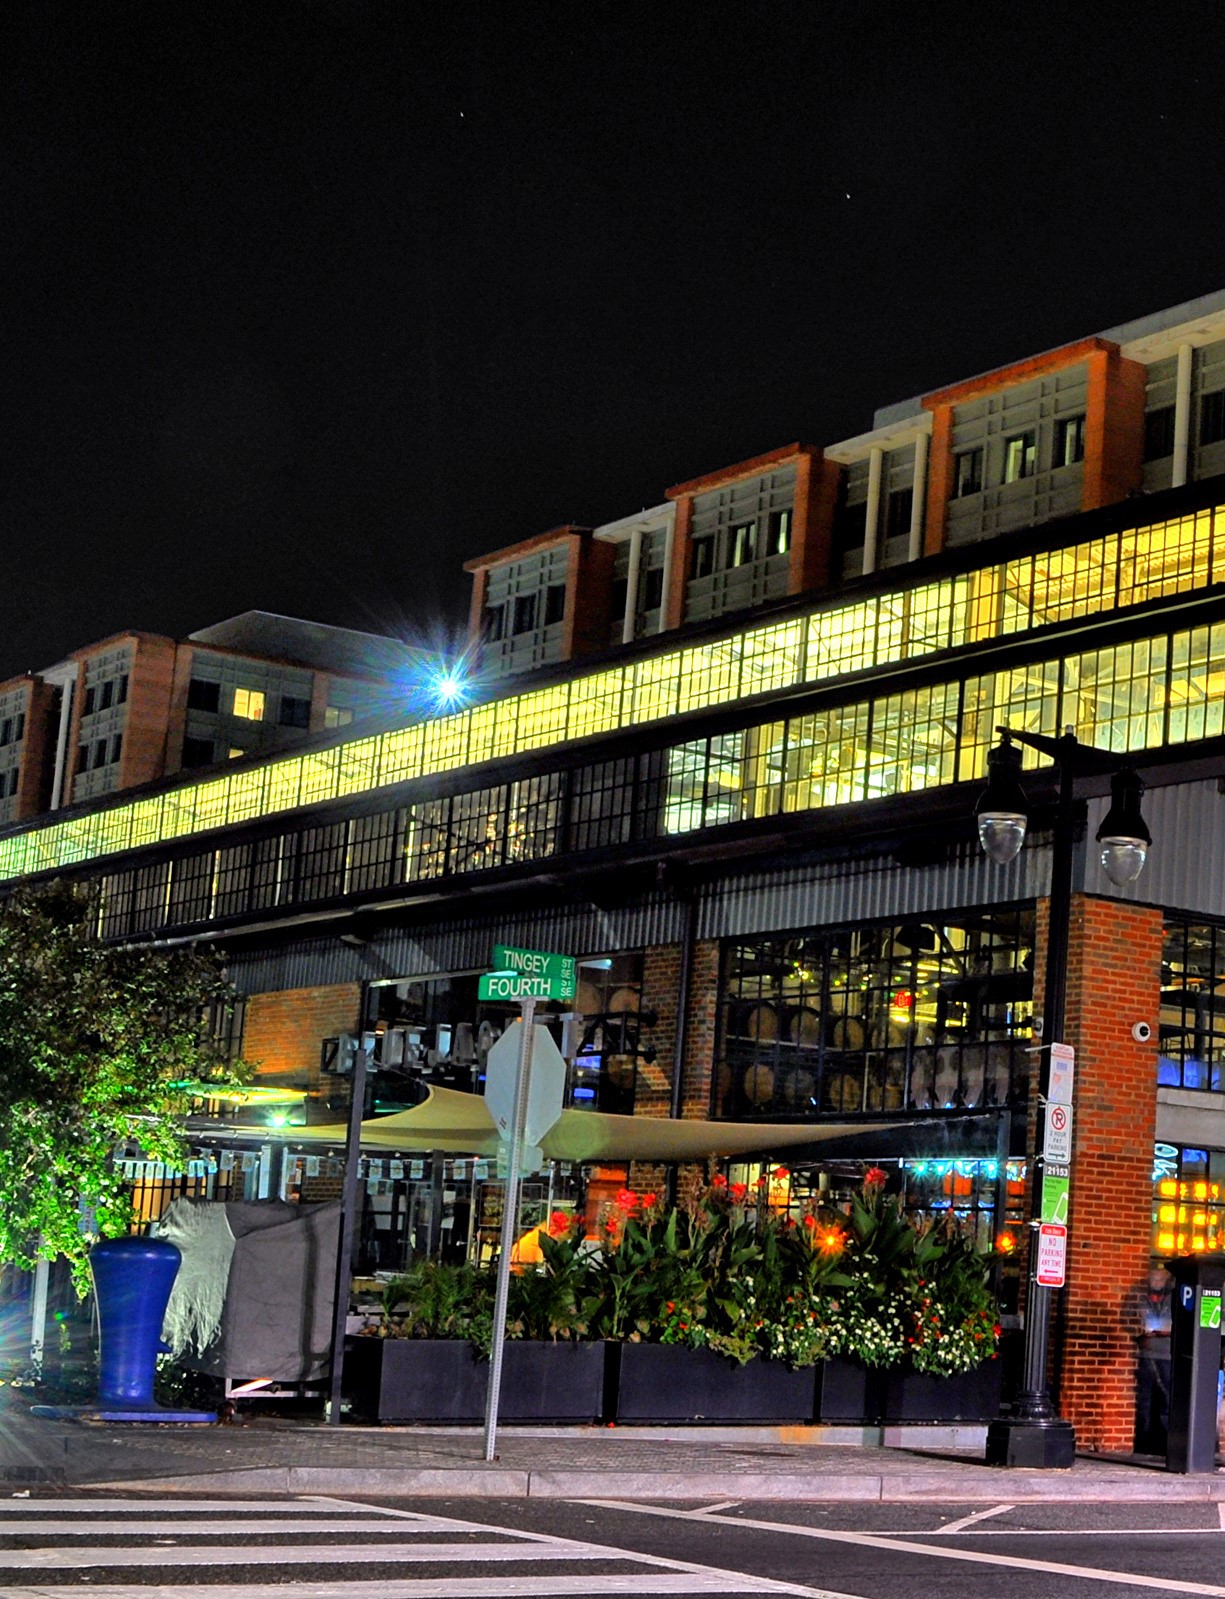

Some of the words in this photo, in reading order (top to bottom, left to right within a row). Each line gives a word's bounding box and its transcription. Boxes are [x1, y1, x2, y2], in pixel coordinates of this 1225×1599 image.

[504, 950, 550, 973] TINGEY
[562, 958, 572, 968] ST
[561, 969, 571, 979] SE
[488, 978, 552, 996] FOURTH
[560, 987, 572, 997] SE
[1047, 1143, 1067, 1152] PARKING
[1047, 1166, 1068, 1177] 21153
[1048, 1237, 1056, 1247] NO
[1041, 1248, 1063, 1258] PARKING
[1051, 1260, 1061, 1268] TIME
[1182, 1286, 1193, 1306] P
